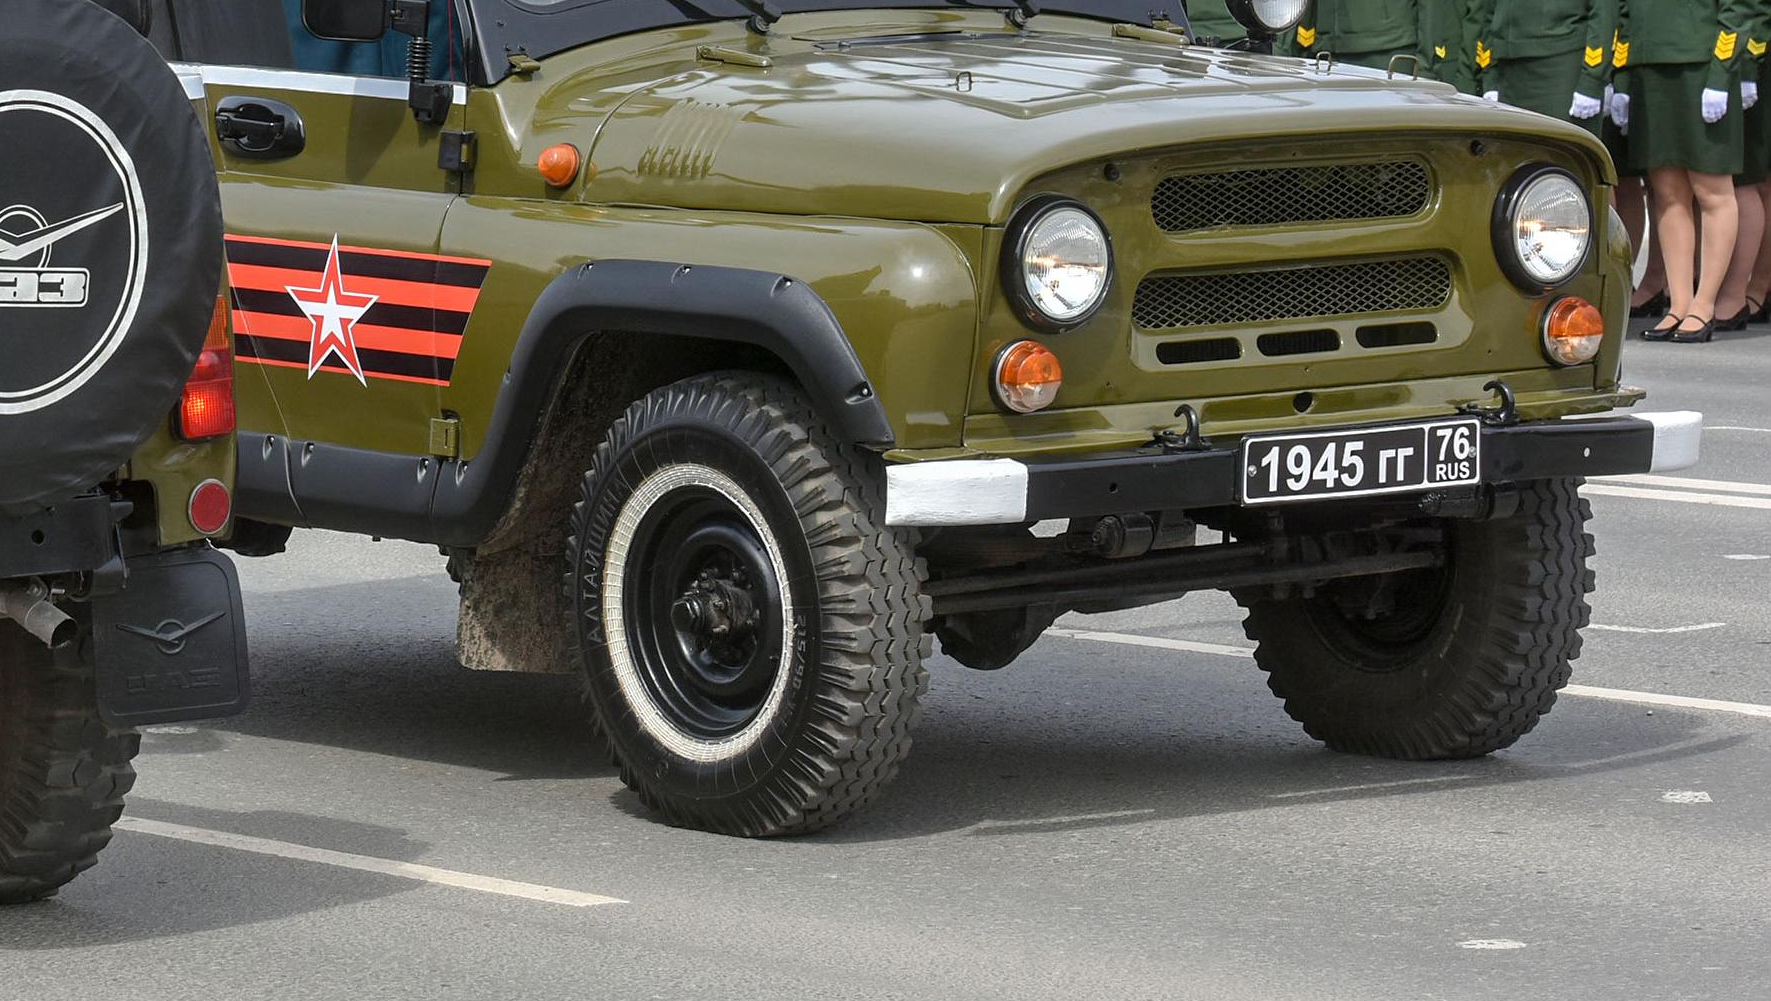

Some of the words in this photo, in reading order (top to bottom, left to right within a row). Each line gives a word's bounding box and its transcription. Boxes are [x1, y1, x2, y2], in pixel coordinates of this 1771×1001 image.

[1436, 427, 1470, 461] 76
[1261, 441, 1364, 492] 1945
[1435, 461, 1470, 481] RUS
